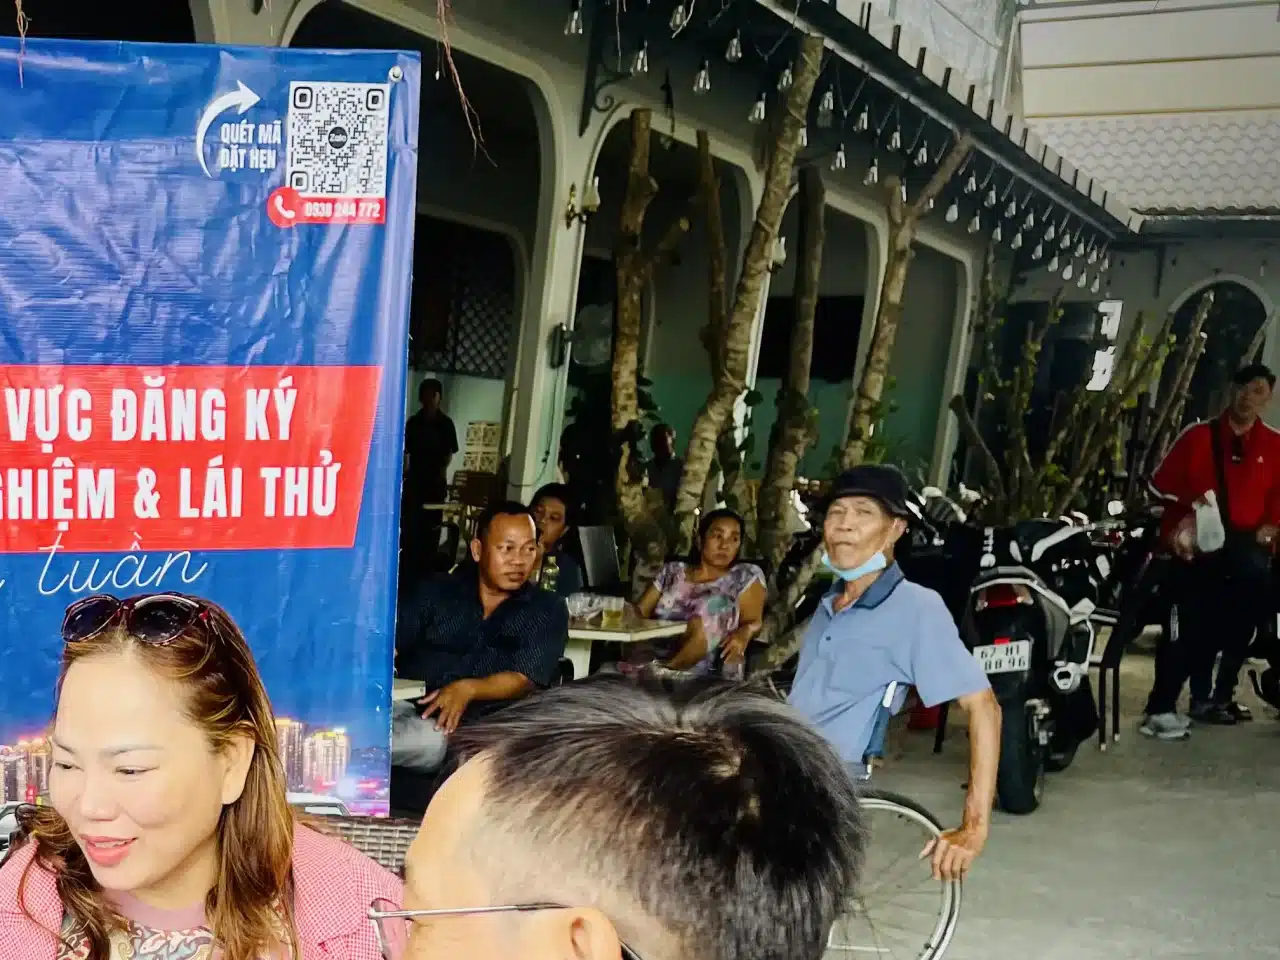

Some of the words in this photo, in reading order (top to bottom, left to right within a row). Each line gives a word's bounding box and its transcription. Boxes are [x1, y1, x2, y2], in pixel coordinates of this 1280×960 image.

[219, 144, 245, 172] ĐẶT
[249, 148, 277, 173] HẸN
[220, 119, 254, 144] QUÉT
[258, 120, 282, 144] MÃ
[5, 384, 92, 453] VỰC
[111, 376, 226, 441] ĐĂNG
[244, 375, 298, 441] KÝ
[133, 468, 161, 519] &
[180, 457, 242, 518] LÁI
[260, 450, 342, 516] THỬ
[38, 528, 209, 595] tuần
